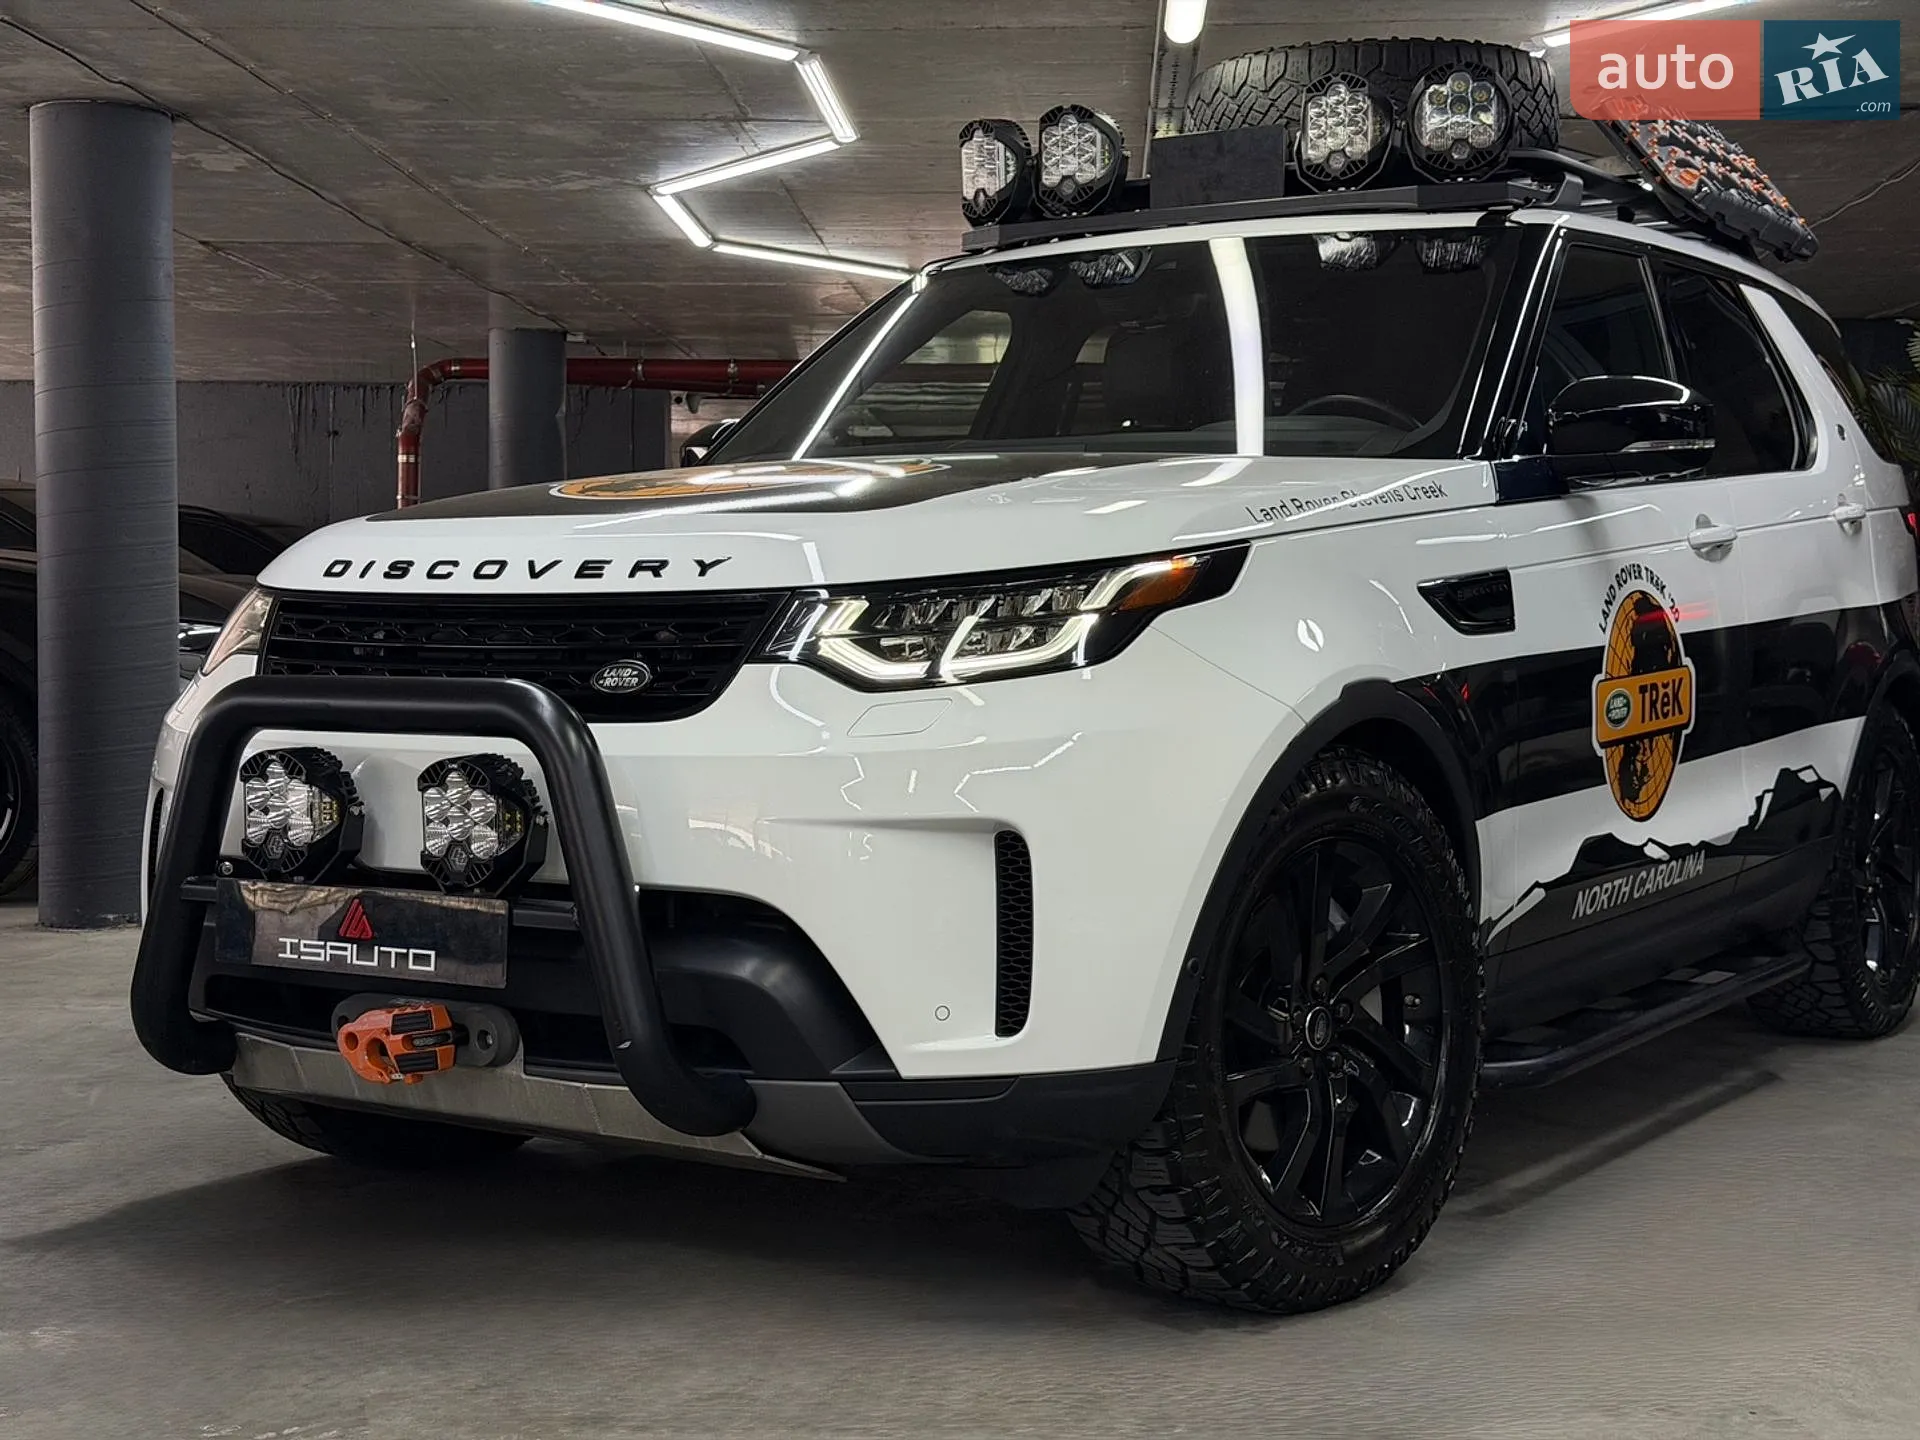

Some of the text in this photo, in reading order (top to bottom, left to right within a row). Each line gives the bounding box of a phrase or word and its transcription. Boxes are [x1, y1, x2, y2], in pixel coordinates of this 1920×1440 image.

[1245, 500, 1293, 523] Land
[1402, 480, 1448, 502] Creek
[322, 556, 733, 580] DISCOVERY
[1599, 584, 1616, 634] LAND
[1615, 563, 1644, 590] ROVER
[1571, 850, 1706, 920] NORTH CAROLINA
[278, 937, 436, 972] ISAUTO
